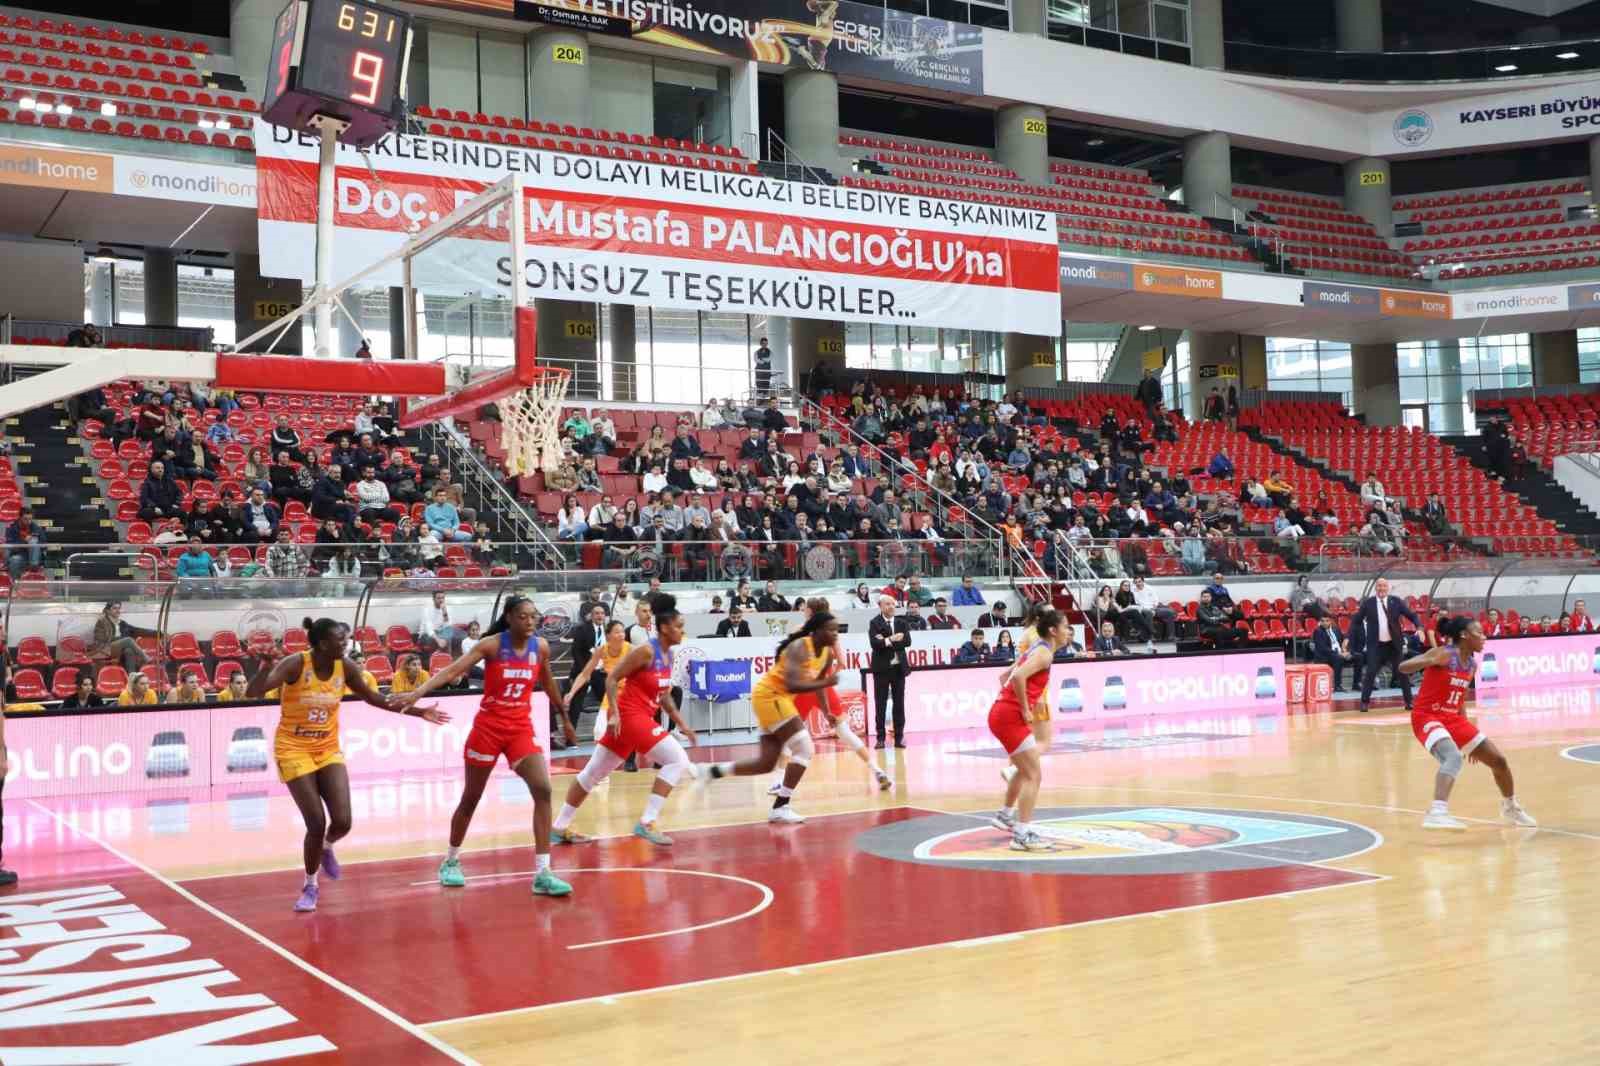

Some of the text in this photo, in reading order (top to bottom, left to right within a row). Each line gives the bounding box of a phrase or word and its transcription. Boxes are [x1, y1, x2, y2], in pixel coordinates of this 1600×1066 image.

[557, 47, 581, 61] 204
[351, 51, 383, 104] 9
[1460, 104, 1536, 124] KAYSERİ
[554, 155, 651, 186] DOLAYI
[919, 199, 1047, 231] BAŞKANIMIZ
[1362, 174, 1383, 183] 201
[337, 176, 439, 231] Doç.
[530, 198, 690, 247] Mustafa
[497, 256, 650, 297] SONSUZ
[715, 672, 746, 682] molten
[1136, 673, 1249, 703] TOPOLINO
